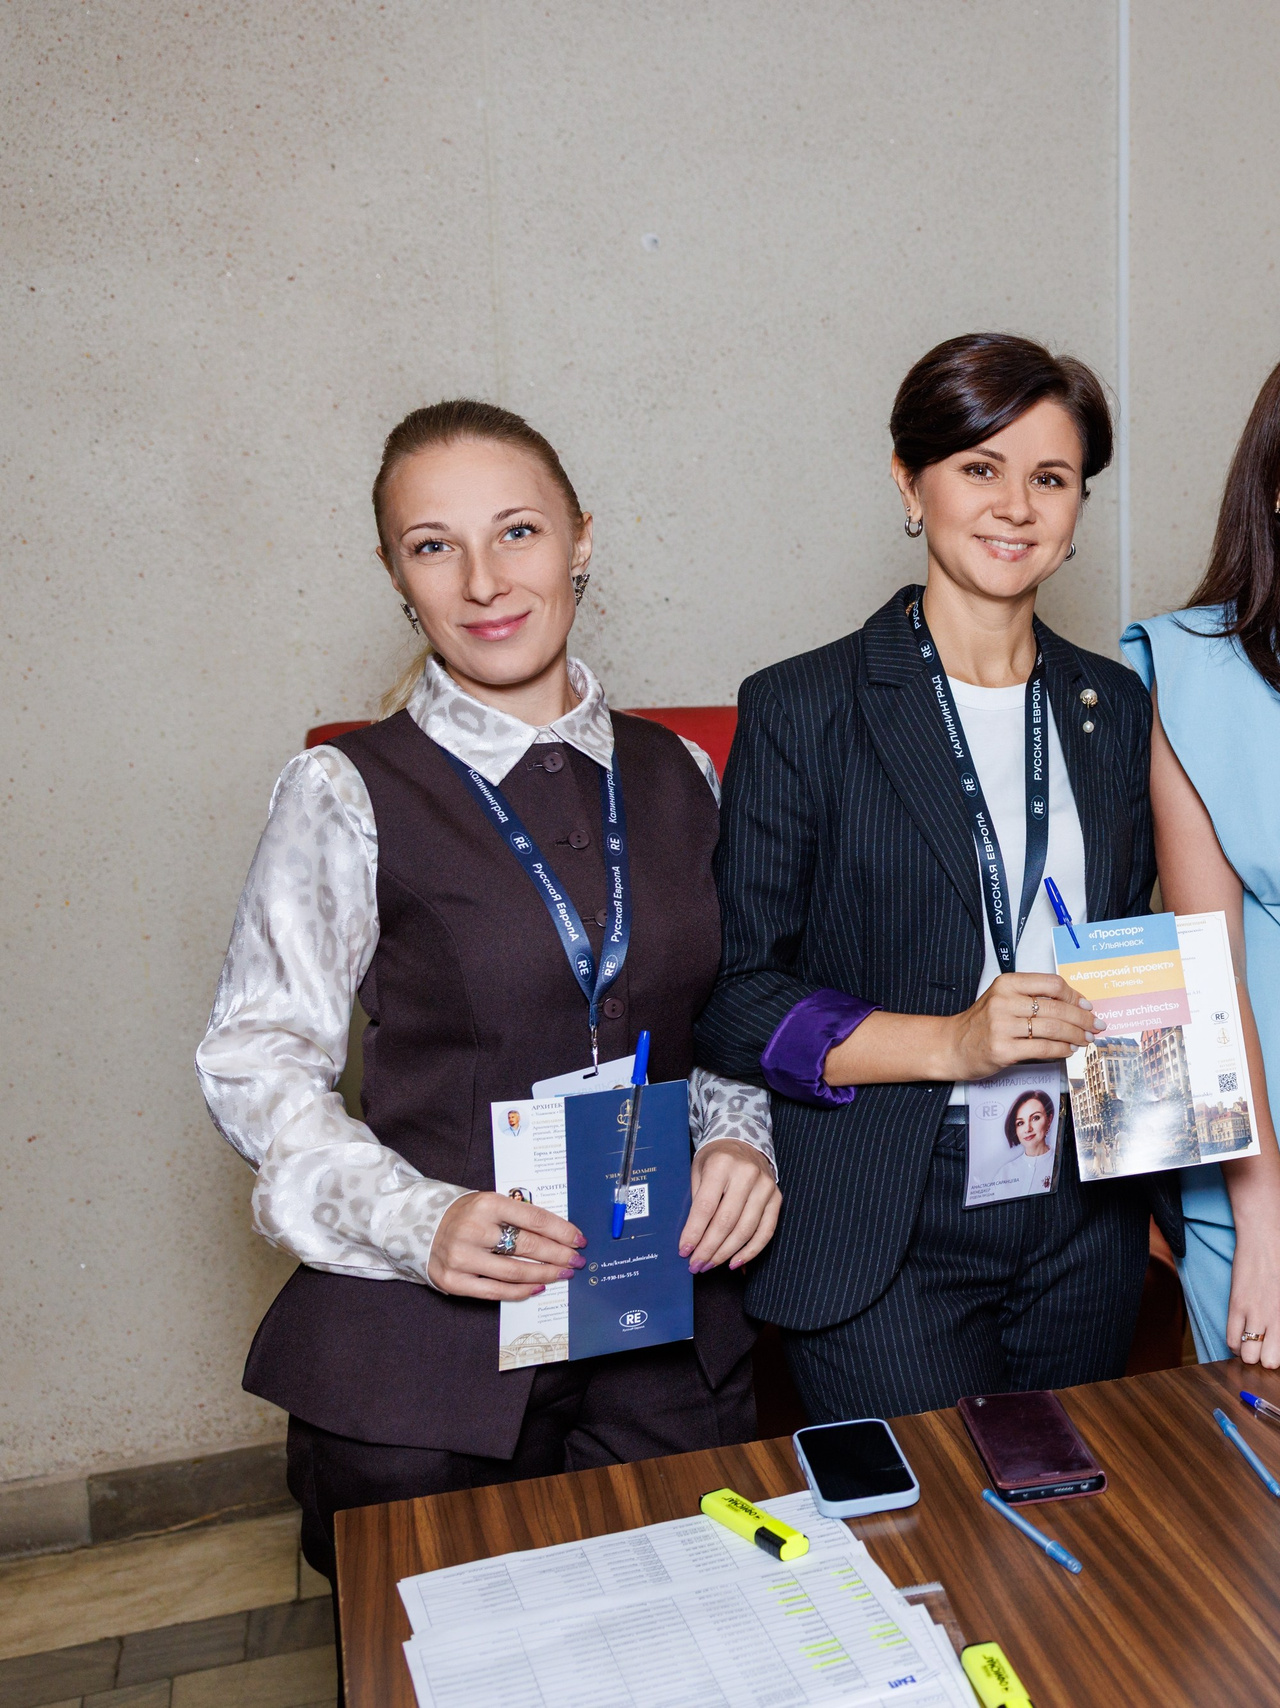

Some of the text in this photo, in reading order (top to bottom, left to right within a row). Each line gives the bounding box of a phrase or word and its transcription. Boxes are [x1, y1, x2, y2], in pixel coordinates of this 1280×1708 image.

[921, 644, 932, 658] RE
[932, 675, 964, 758] КАЛИНИНГРАД
[1033, 678, 1042, 781] РУССКАЯ ЕВРОПА
[963, 778, 976, 792] RE
[1033, 801, 1043, 814] RE
[513, 835, 529, 850] RE
[610, 837, 620, 851] RE
[976, 812, 1004, 924] РУССКАЯ ЕВРОПА
[1088, 926, 1144, 939] «Простор»
[1098, 939, 1144, 950] Ульяновск
[1000, 948, 1009, 960] RE
[577, 960, 590, 975] RE
[604, 962, 616, 977] RE
[1070, 961, 1174, 981] «Авторский проект»
[1111, 978, 1144, 988] Тюмень
[1126, 1002, 1179, 1016] architects»
[1215, 1013, 1225, 1021] RE
[978, 1074, 1051, 1088] АДМИРАЛЬСКИЙ
[982, 1105, 998, 1117] RE
[626, 1313, 641, 1325] RE
